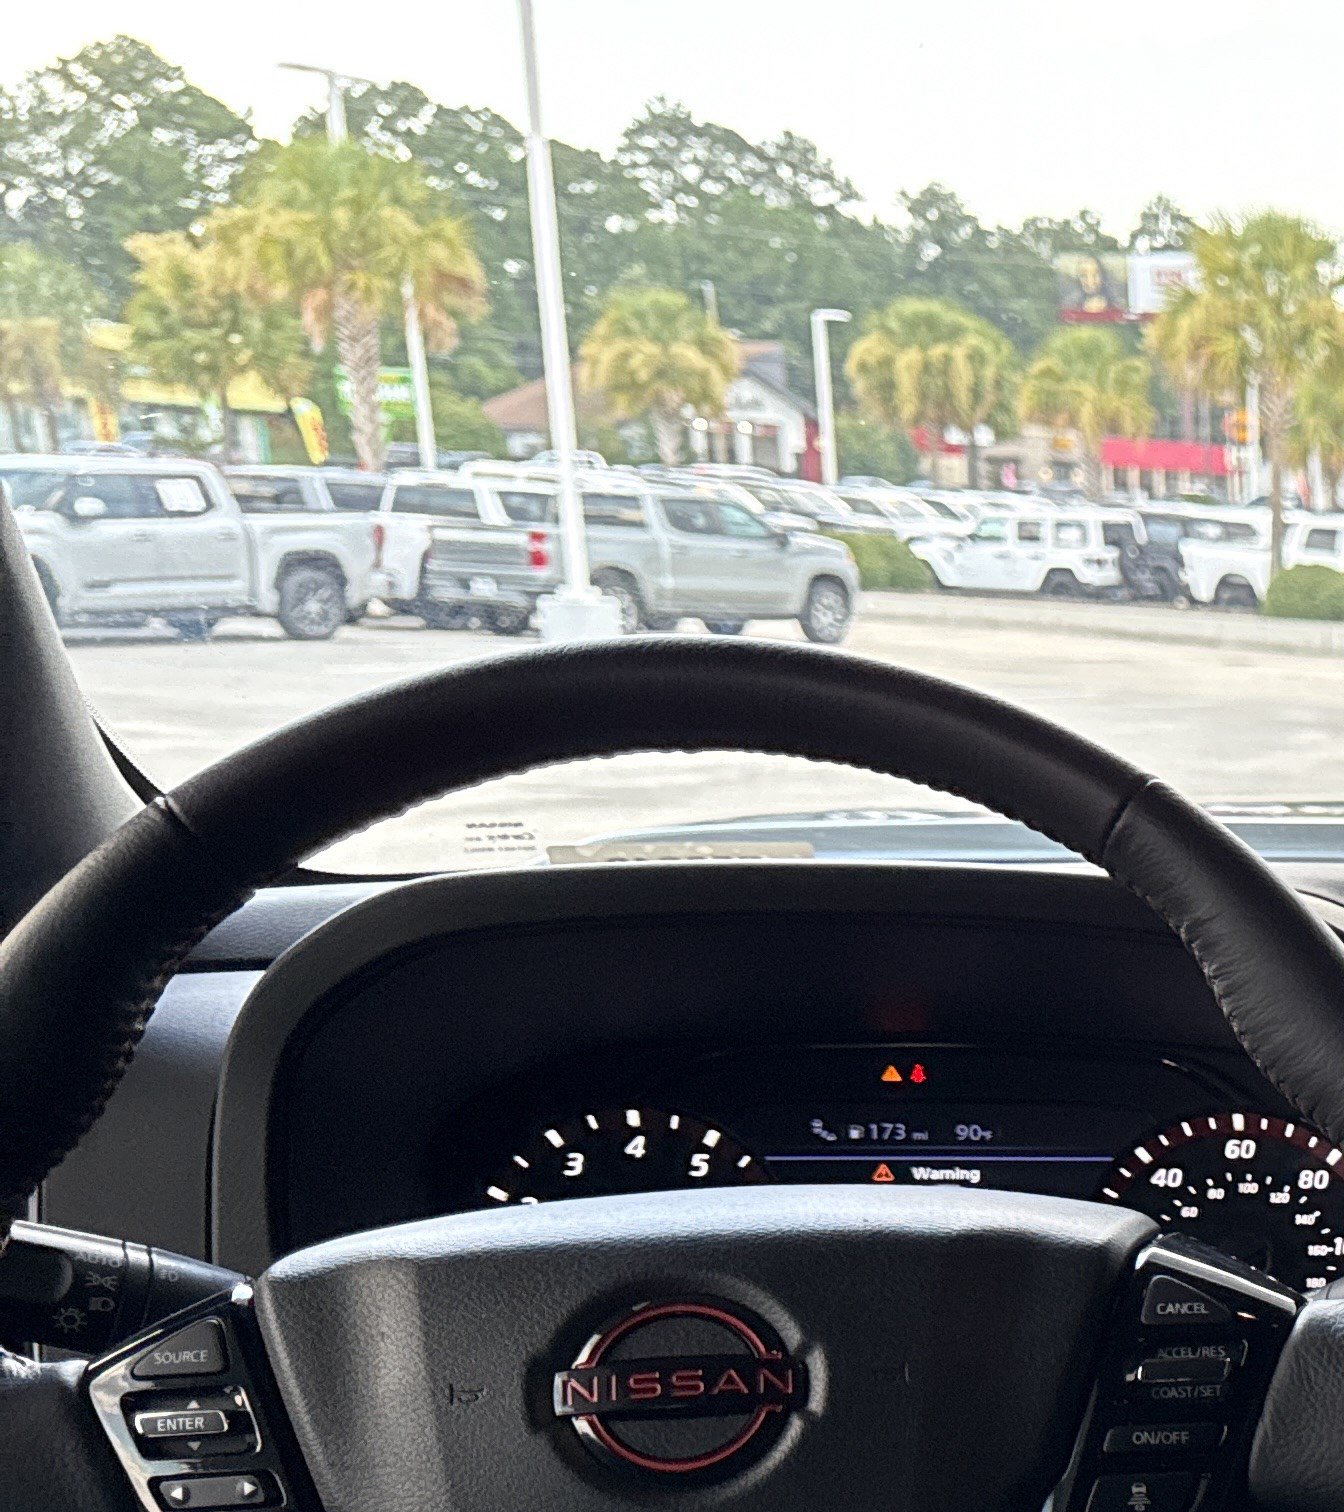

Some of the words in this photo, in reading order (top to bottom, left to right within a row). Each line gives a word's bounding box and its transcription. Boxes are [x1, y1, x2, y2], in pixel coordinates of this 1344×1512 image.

[868, 1122, 906, 1141] 173
[624, 1135, 646, 1158] 4
[1224, 1139, 1257, 1160] 60
[562, 1152, 585, 1177] 3
[688, 1153, 710, 1177] 5
[909, 1166, 981, 1184] Warning
[1150, 1167, 1184, 1188] 40
[1297, 1169, 1330, 1190] 80
[1206, 1188, 1226, 1200] 80
[1237, 1182, 1260, 1194] 100
[1180, 1206, 1199, 1218] 60
[1155, 1302, 1210, 1316] CANCEL
[152, 1348, 209, 1366] SOURCE
[565, 1367, 795, 1407] NISSAN
[1151, 1385, 1222, 1399] COAST/SET
[156, 1415, 205, 1433] ENTER
[1132, 1431, 1191, 1445] ON/OFF
